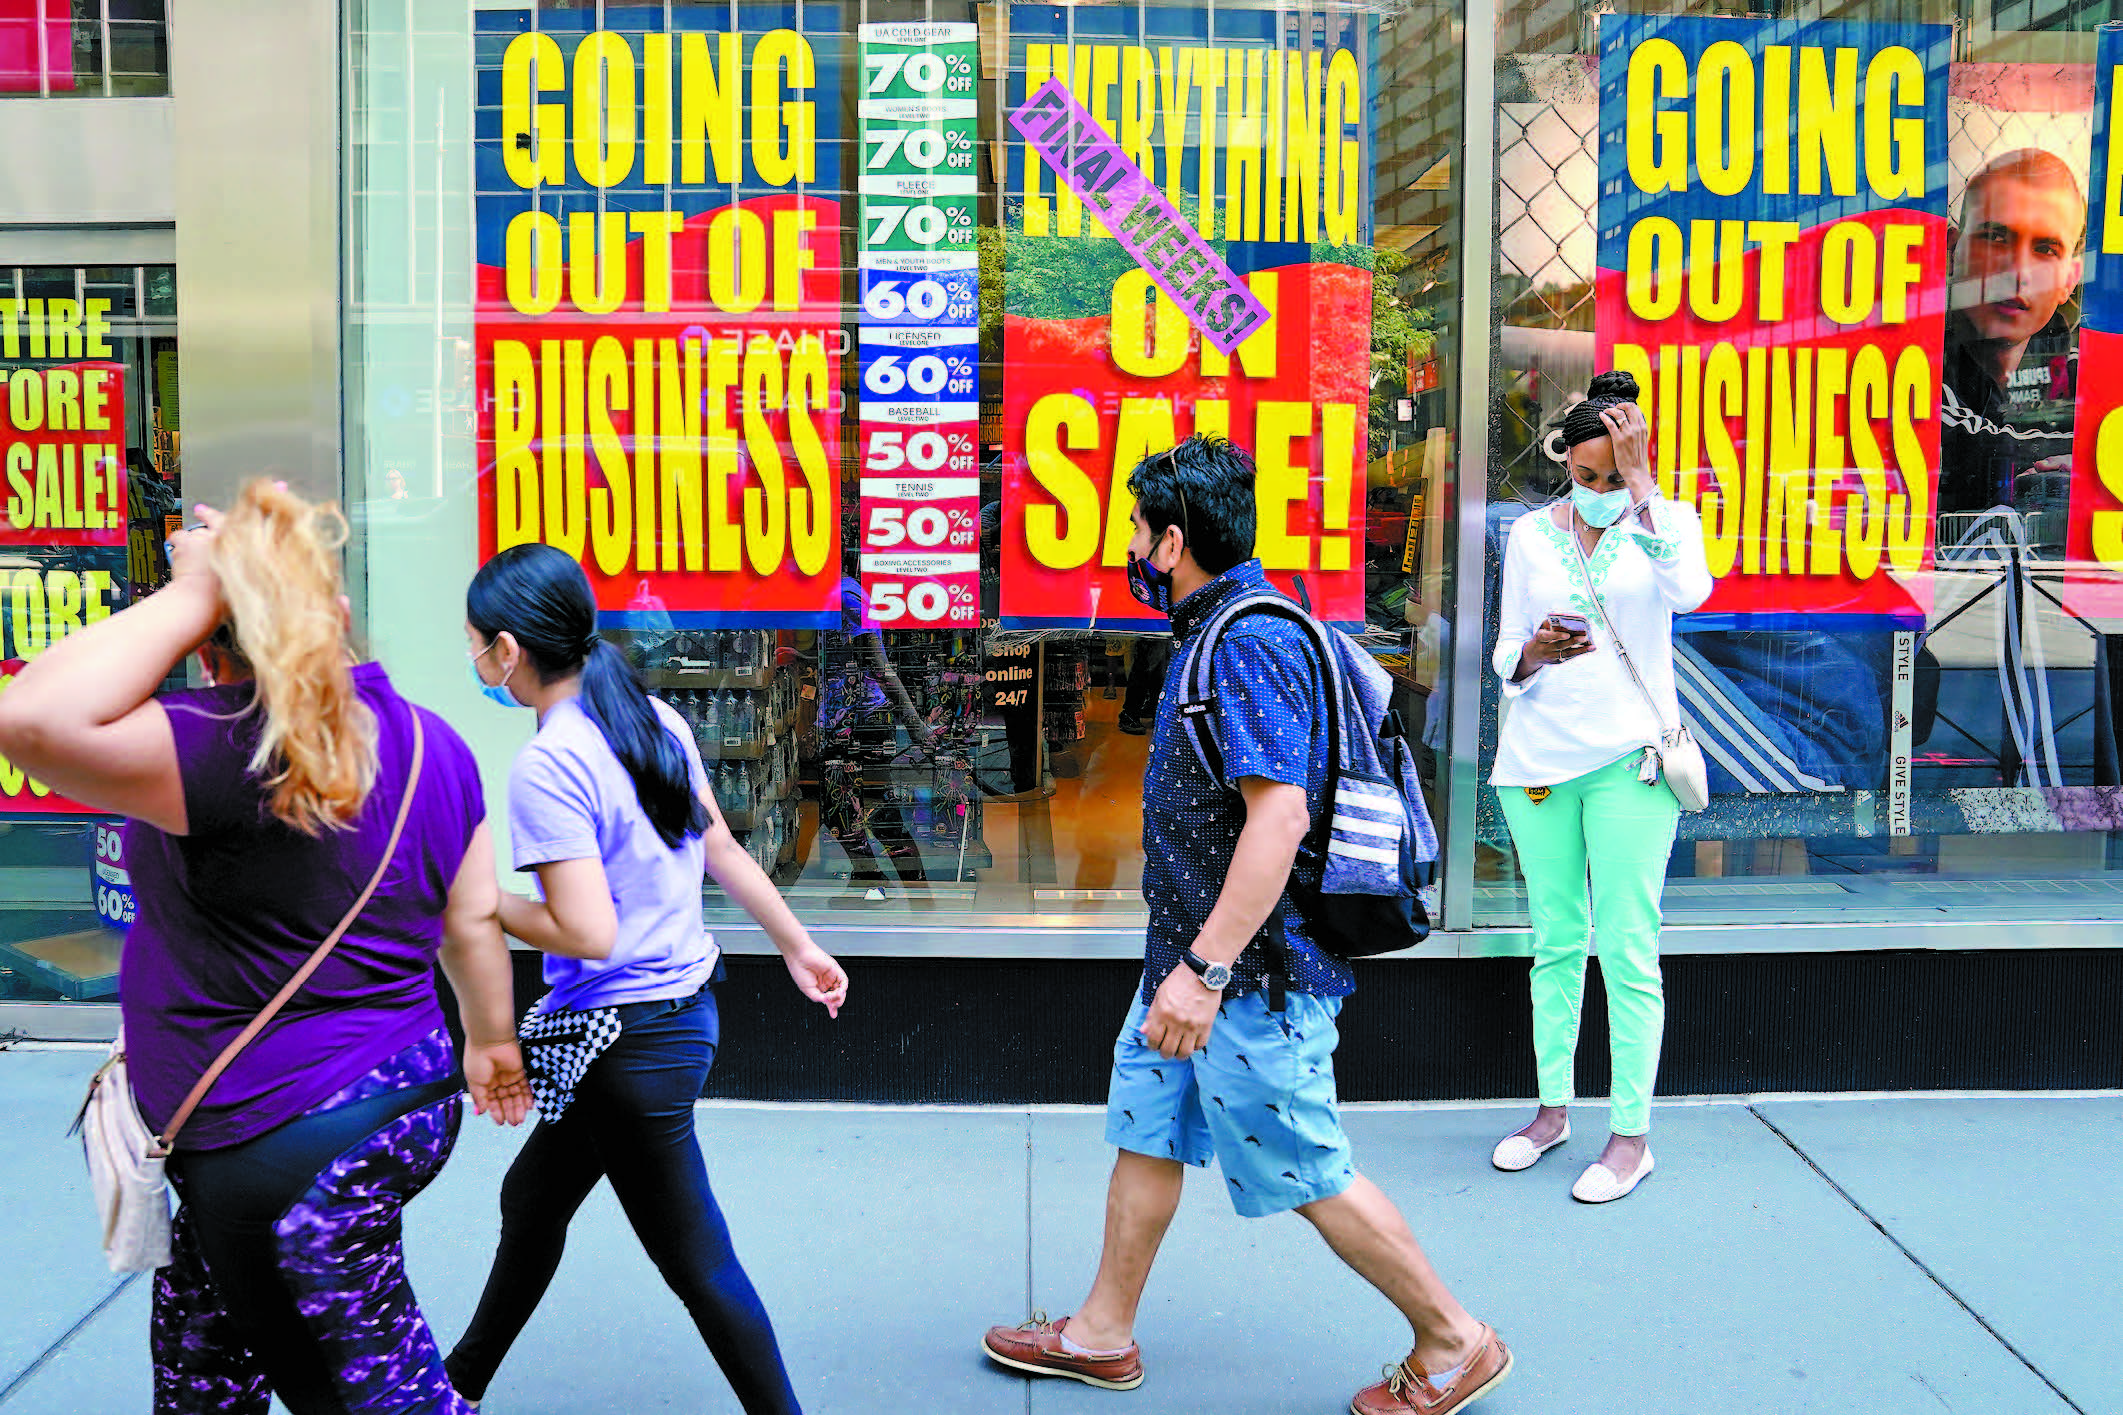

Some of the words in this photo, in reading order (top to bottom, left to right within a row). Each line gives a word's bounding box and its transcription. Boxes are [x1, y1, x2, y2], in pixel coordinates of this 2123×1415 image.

[875, 28, 890, 37] UA
[892, 28, 920, 37] COLD
[924, 28, 951, 37] GEAR
[947, 76, 972, 92] OFF
[502, 29, 816, 189] GOING
[1627, 37, 1925, 200] GOING
[1023, 43, 1360, 248] EVERYTHING
[947, 152, 972, 168] OFF
[896, 181, 935, 189] FLEECE
[1021, 88, 1127, 210] FINAL
[1118, 192, 1259, 345] WEEKS!
[947, 228, 973, 244] OFF
[505, 210, 684, 315] OUT
[708, 208, 816, 315] OF
[1626, 215, 1800, 322] OUT
[1820, 221, 1925, 325] OF
[948, 304, 972, 319] OFF
[1110, 268, 1279, 378] ON
[889, 332, 940, 340] LICENSED
[948, 379, 973, 394] OFF
[0, 369, 110, 431] ORE
[888, 407, 940, 416] BASEBALL
[494, 336, 832, 577] BUSINESS
[949, 455, 974, 471] OFF
[6, 441, 118, 529] SALE!
[895, 483, 934, 492] TENNIS
[1024, 393, 1356, 571] SAE!
[949, 531, 975, 545] OFF
[949, 606, 975, 621] OFF
[1898, 637, 1910, 681] STYLE
[985, 665, 1033, 682] online
[995, 689, 1028, 707] 24/7
[1895, 756, 1906, 787] GIVE
[1894, 791, 1906, 834] STYLE
[97, 826, 123, 862] 50
